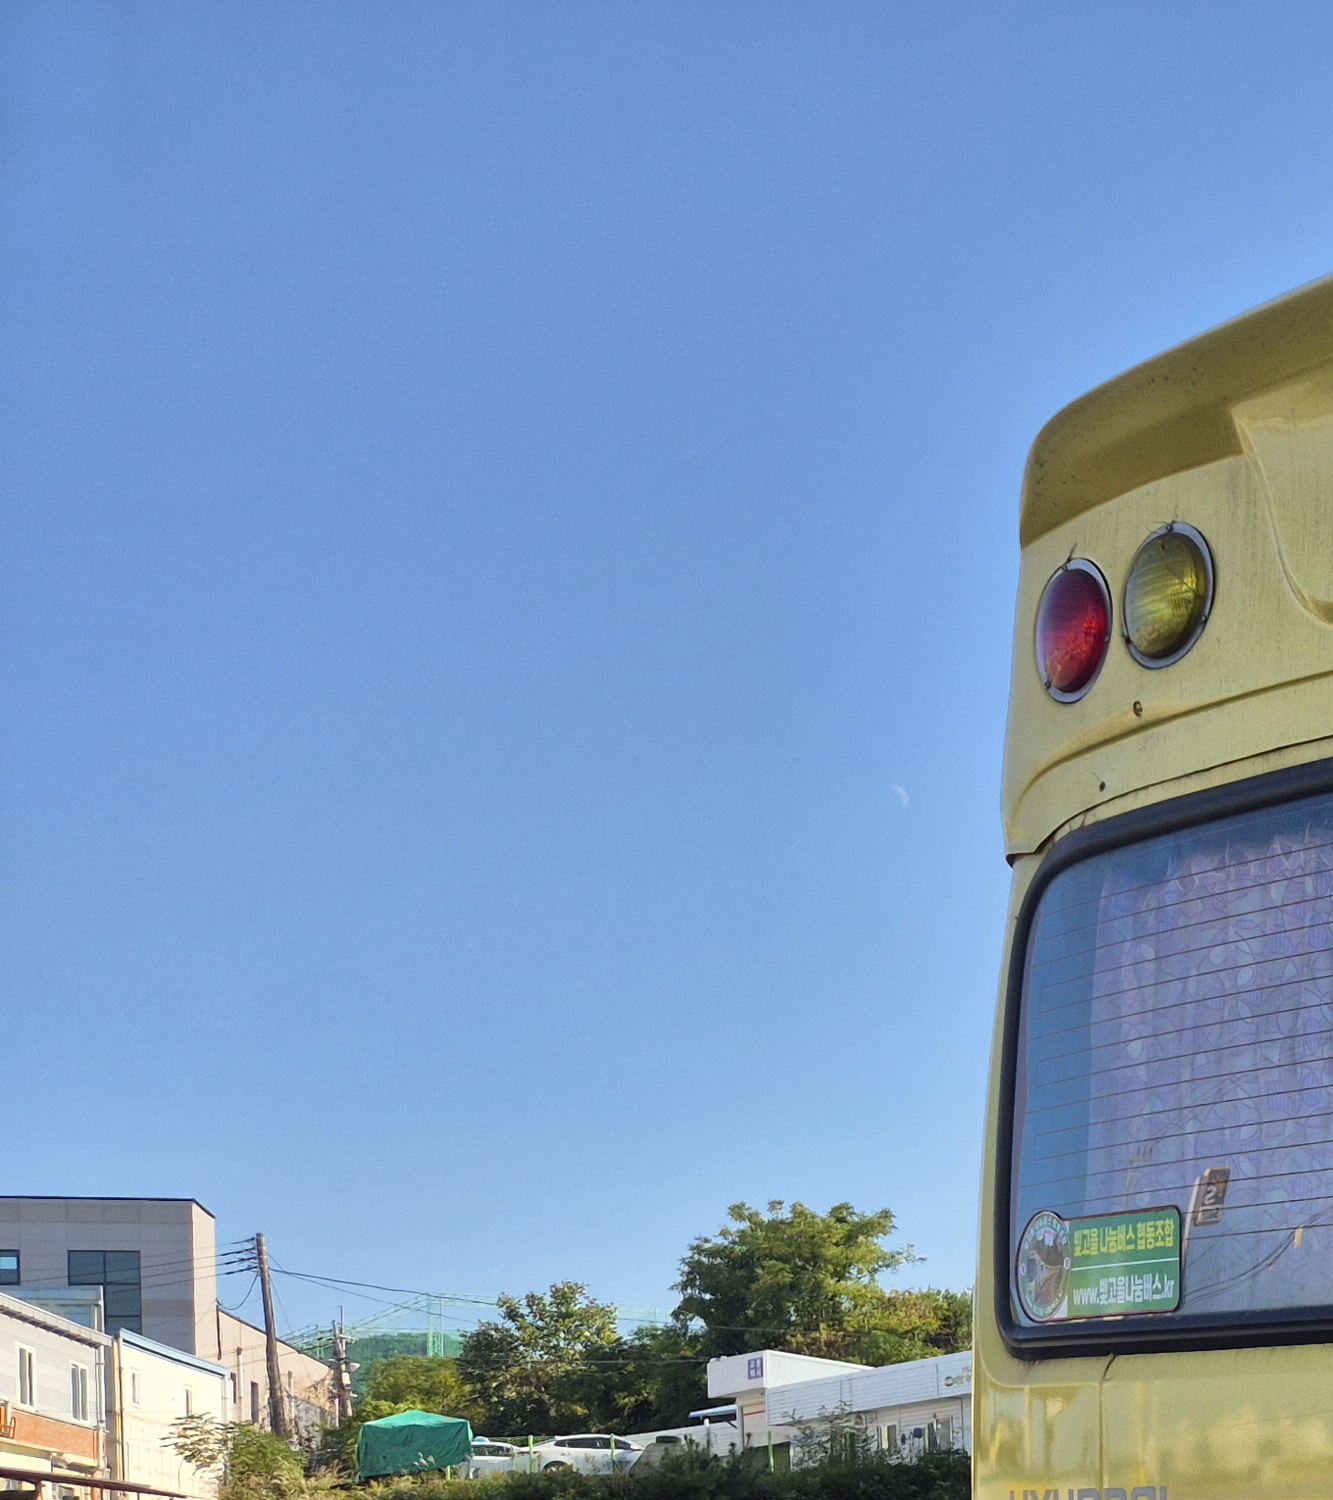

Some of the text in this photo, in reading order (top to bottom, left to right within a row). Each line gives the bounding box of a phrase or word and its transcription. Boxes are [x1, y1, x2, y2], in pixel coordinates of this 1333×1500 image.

[1073, 1228, 1099, 1257] 빛고을
[1100, 1224, 1135, 1254] 나눔버스
[1137, 1218, 1175, 1250] 협동조합
[1073, 1272, 1175, 1306] www.빛고을나눔버스.kr
